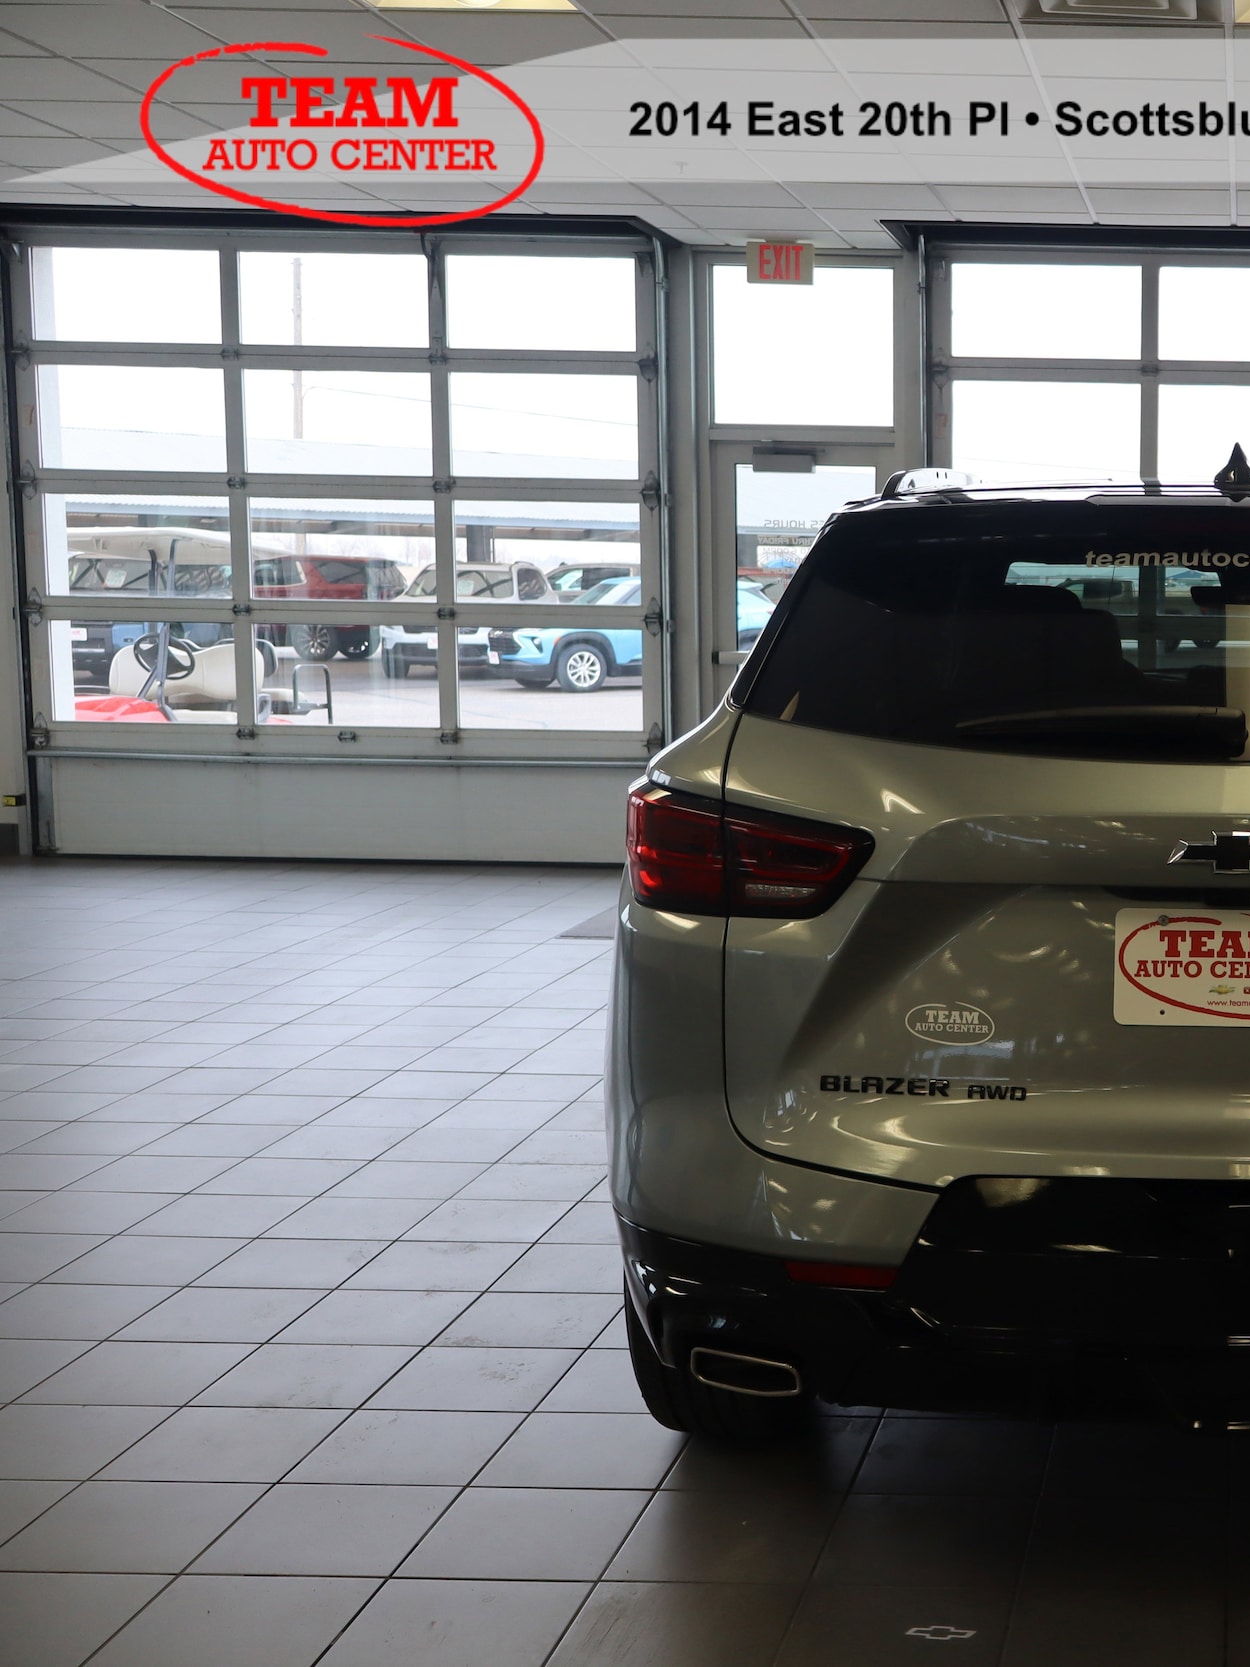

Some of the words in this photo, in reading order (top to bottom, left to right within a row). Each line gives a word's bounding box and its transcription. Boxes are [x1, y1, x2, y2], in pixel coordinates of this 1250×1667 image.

[758, 243, 804, 281] EXIT
[1134, 960, 1202, 978] AUTO
[925, 1009, 980, 1024] TEAM
[914, 1022, 943, 1032] AUTO
[946, 1023, 990, 1034] CENTER
[819, 1075, 950, 1097] BLAZER
[967, 1084, 1028, 1101] AWD
